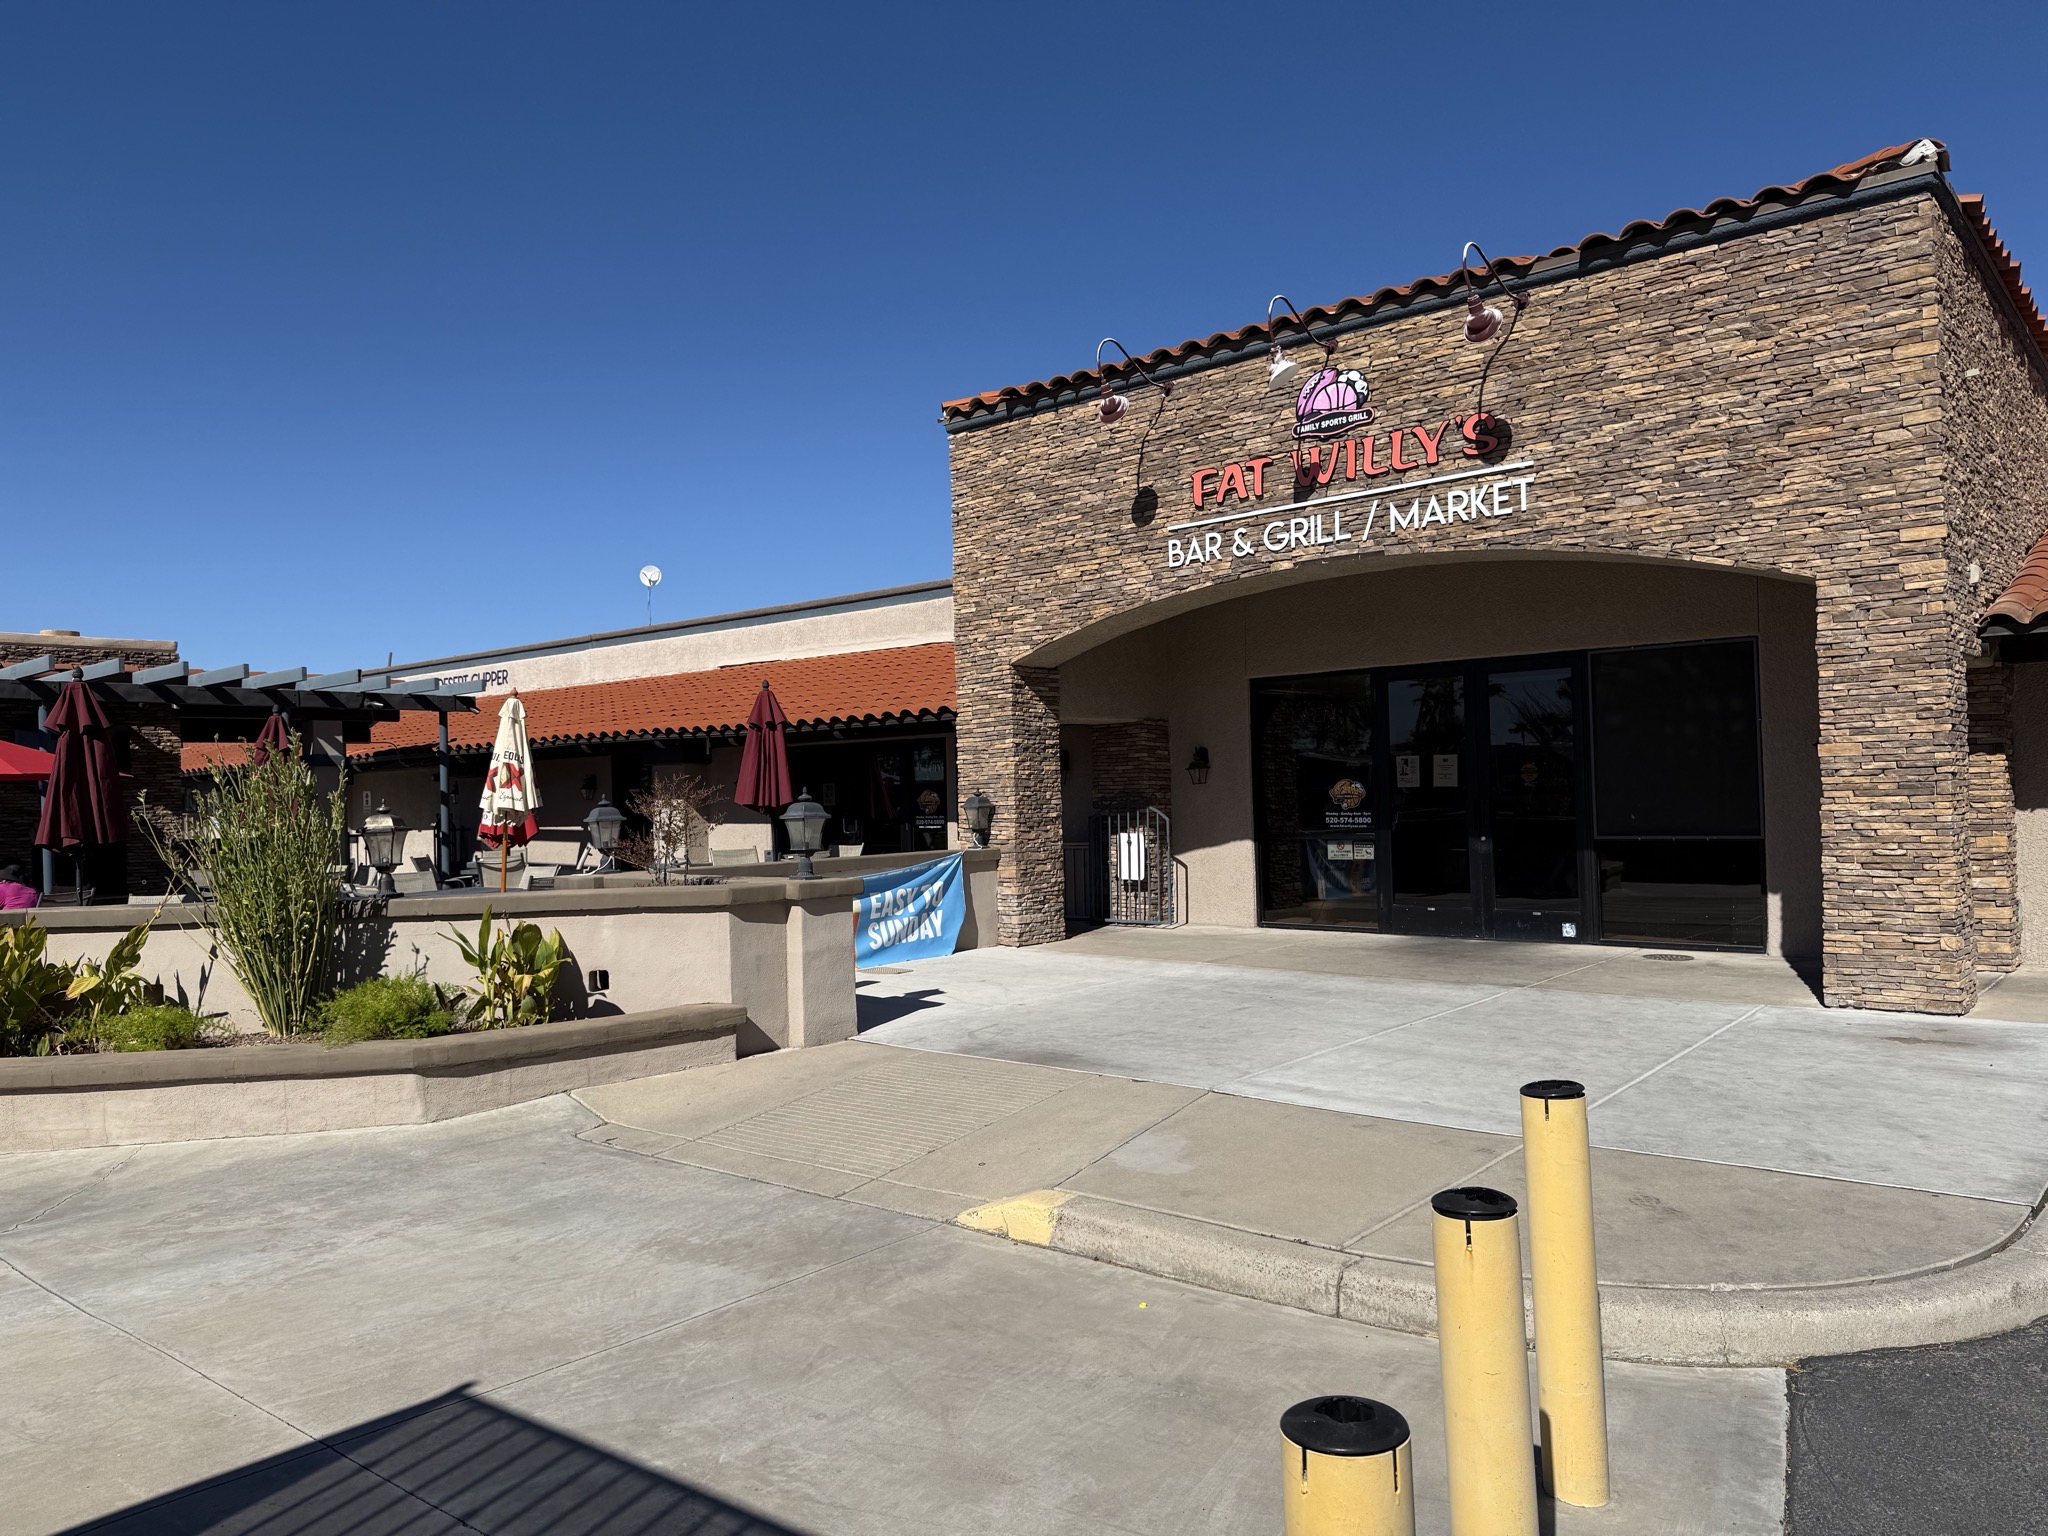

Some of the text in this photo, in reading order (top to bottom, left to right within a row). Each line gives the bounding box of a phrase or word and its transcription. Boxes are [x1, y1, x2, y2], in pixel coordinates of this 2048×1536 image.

[1297, 412, 1368, 434] FAMILY SPORTS GRILL
[1191, 412, 1499, 508] FAT WILLY'S
[1168, 477, 1535, 568] BAR & GRILL / MARKET
[870, 881, 944, 919] EASY TO
[867, 910, 944, 950] SUNDAY
